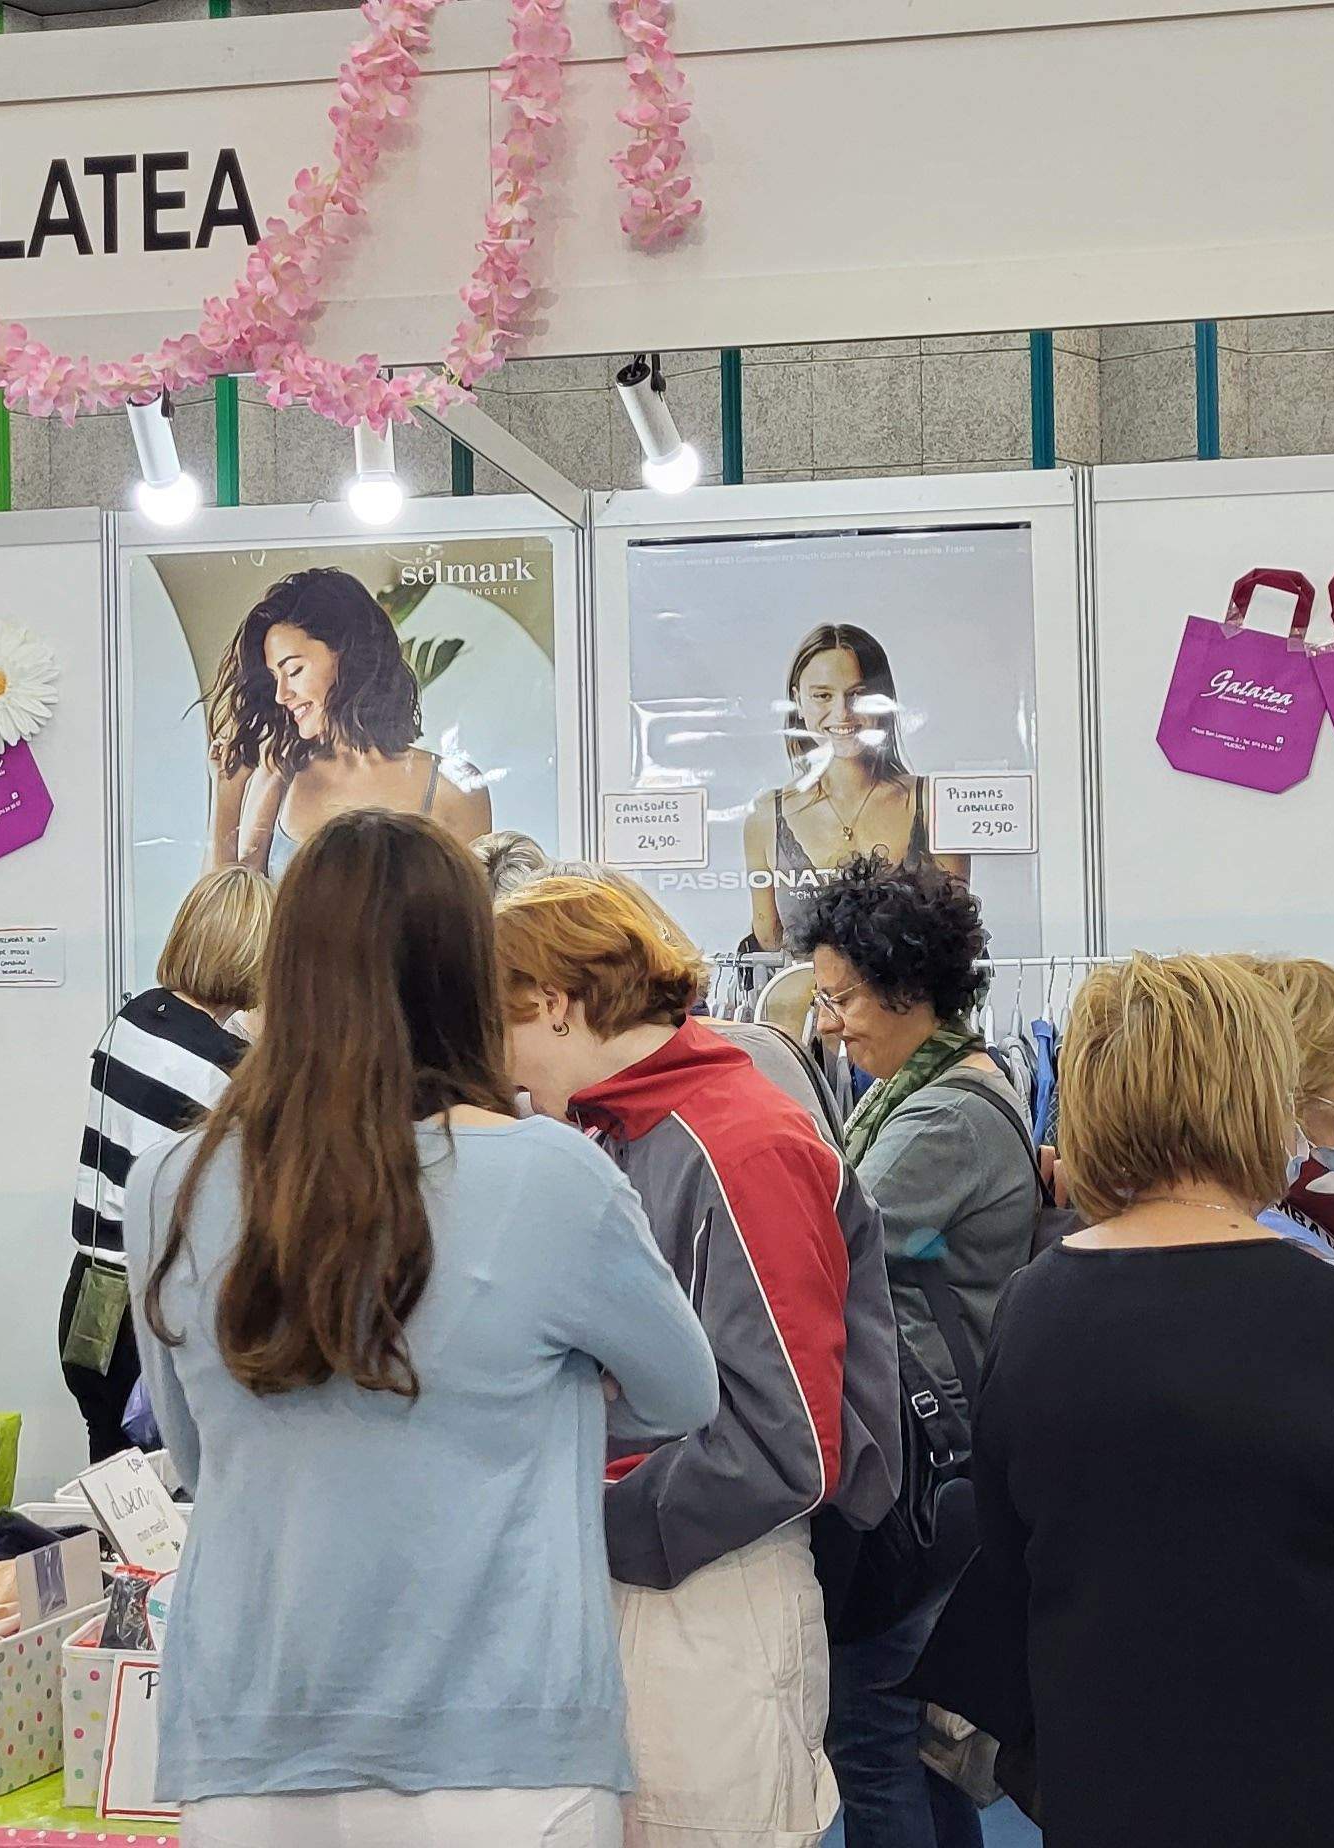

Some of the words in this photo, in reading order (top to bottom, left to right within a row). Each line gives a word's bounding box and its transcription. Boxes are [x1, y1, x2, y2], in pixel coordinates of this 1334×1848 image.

[401, 557, 536, 586] selmark
[470, 586, 519, 596] INGERIE
[1200, 670, 1293, 705] Galatea
[946, 787, 1003, 800] PIJAMAS
[615, 801, 679, 812] CAMISONES
[957, 803, 1015, 813] CABALLERO
[616, 814, 681, 824] CAMISOLAS
[658, 868, 839, 892] PASSIONAT
